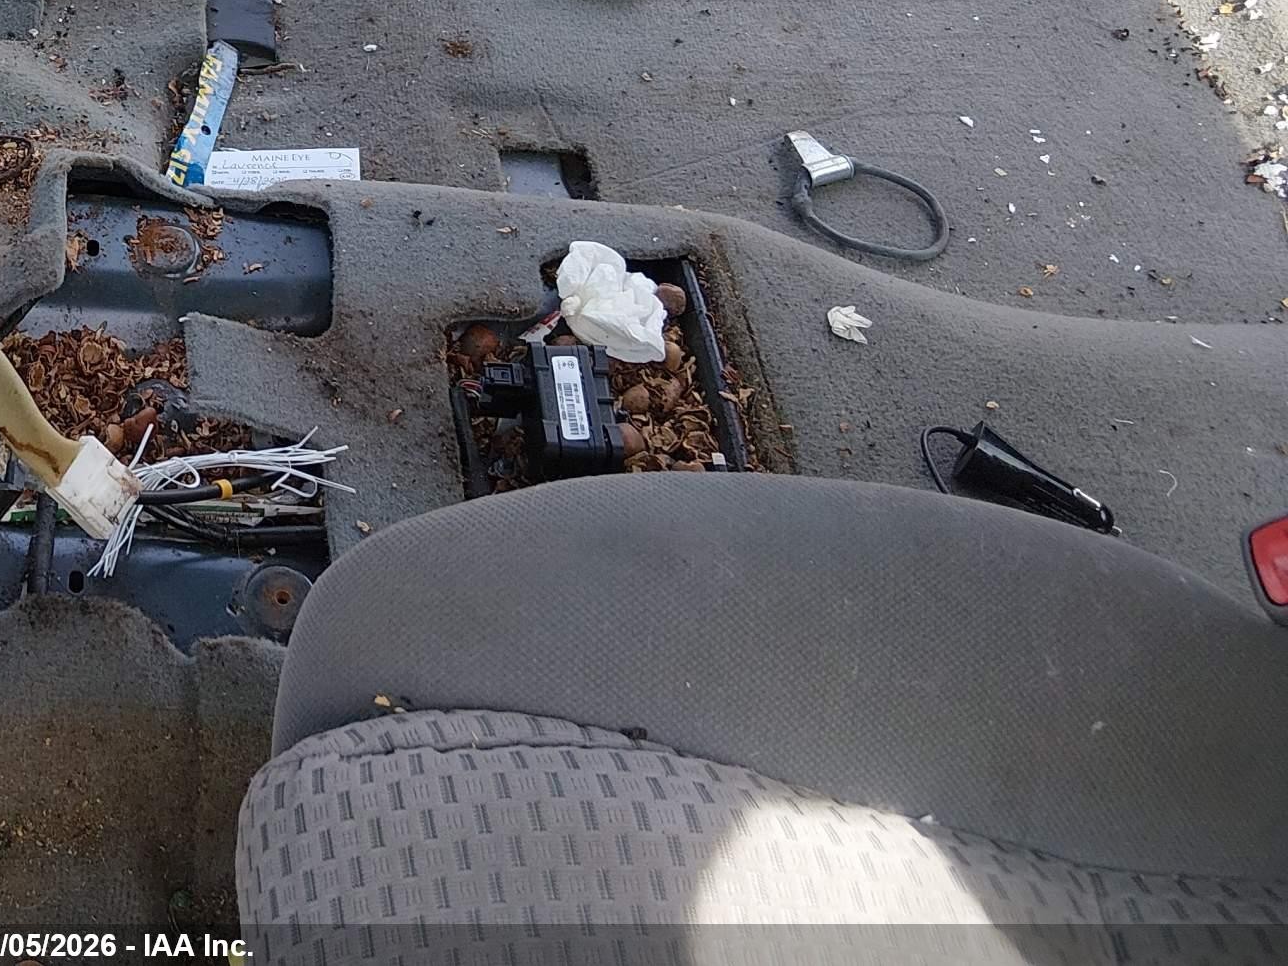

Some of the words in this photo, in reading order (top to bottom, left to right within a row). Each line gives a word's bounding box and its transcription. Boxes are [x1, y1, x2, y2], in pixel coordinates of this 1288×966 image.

[181, 53, 223, 146] FAMILY
[252, 153, 289, 162] MAINE
[291, 153, 312, 162] EYE
